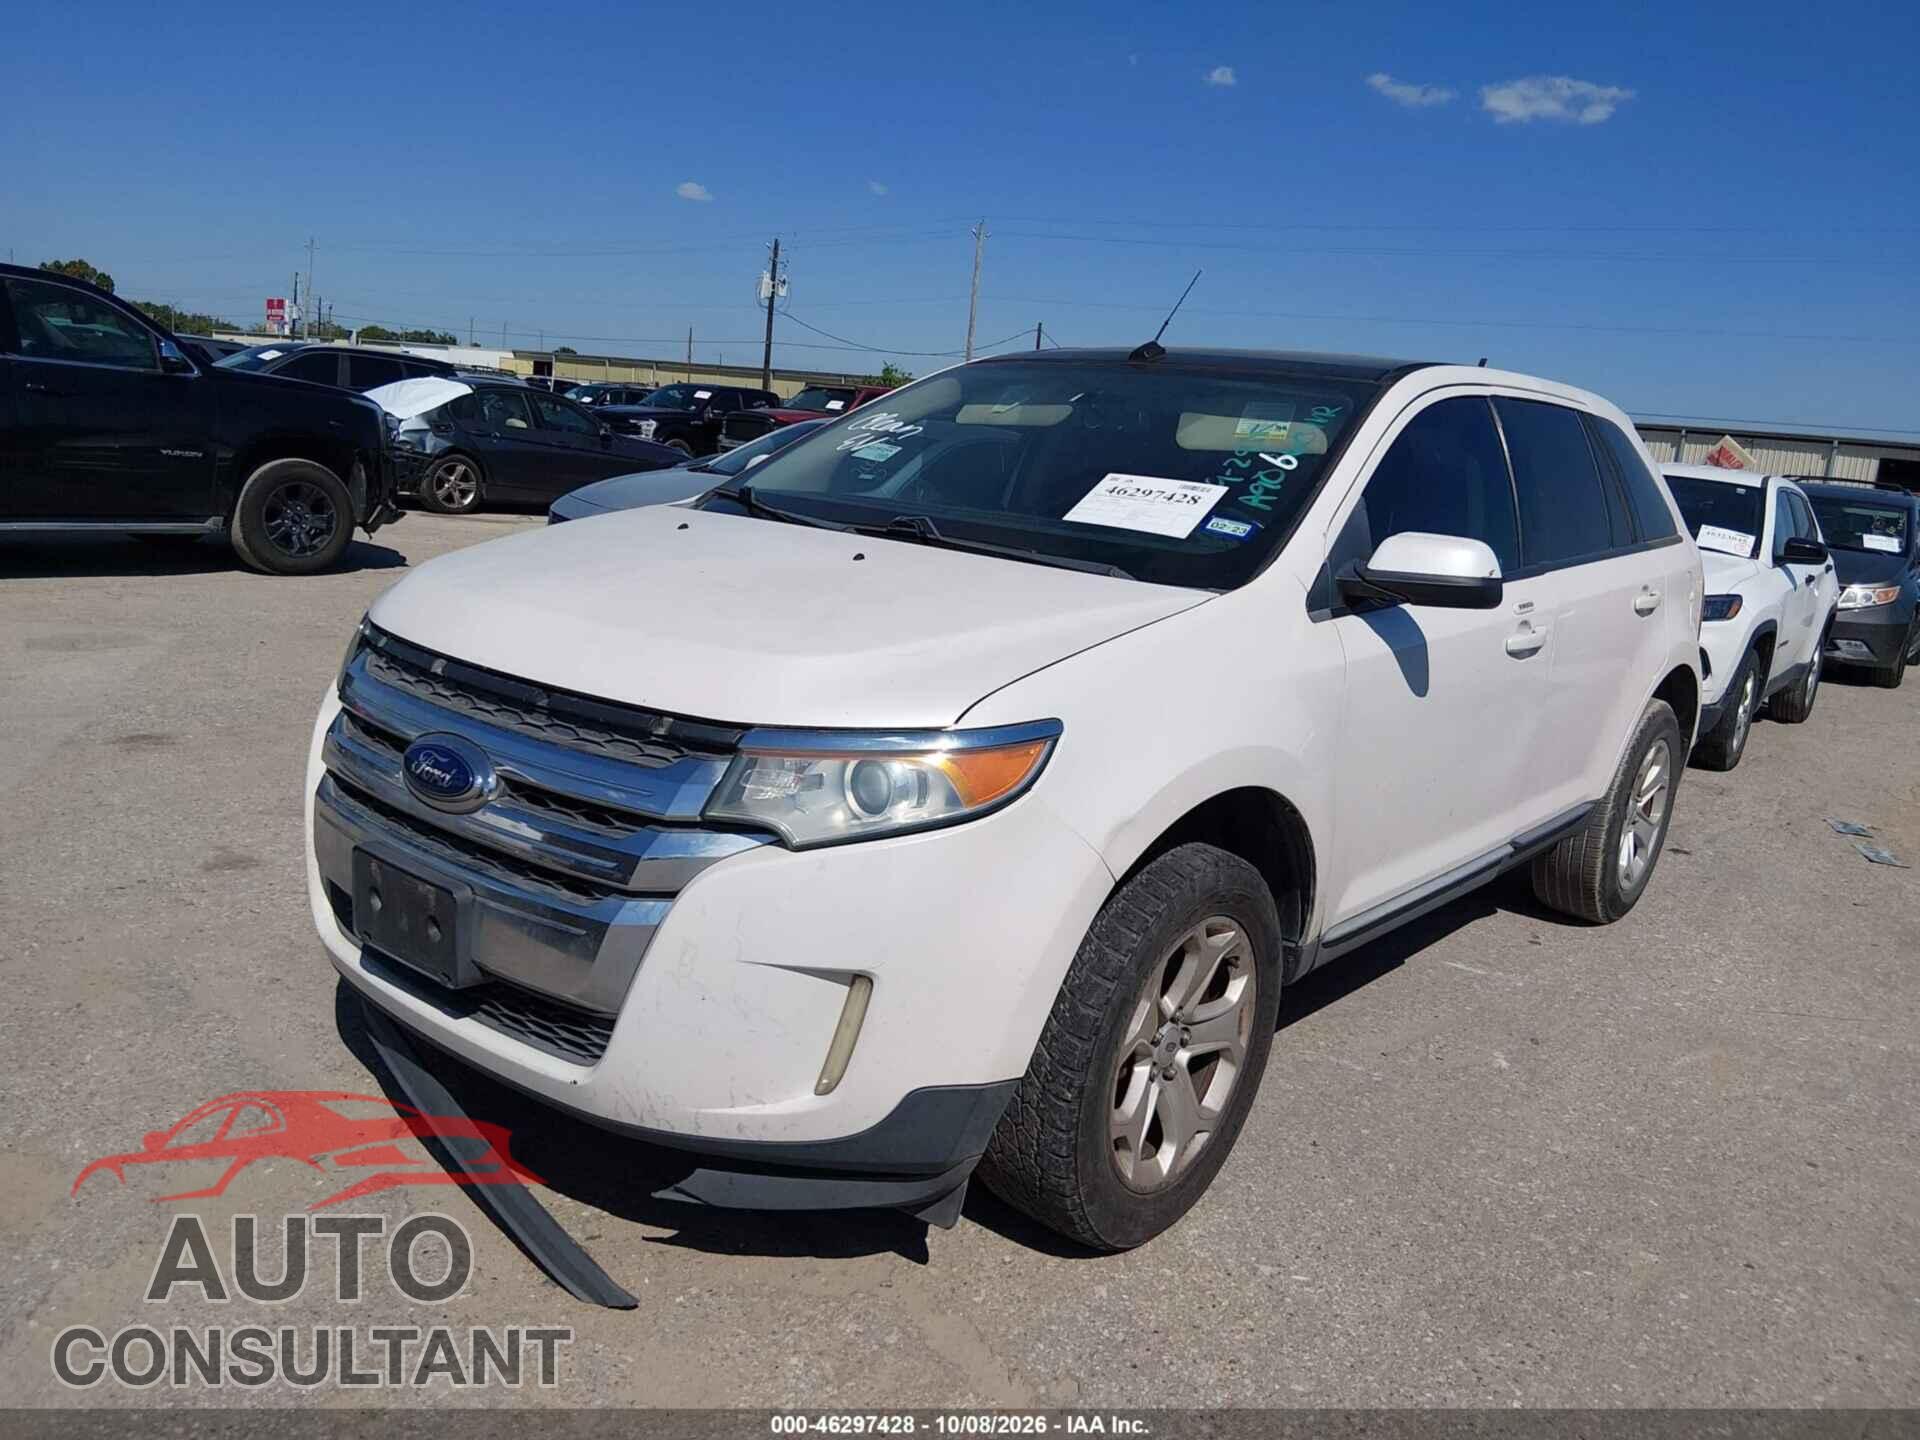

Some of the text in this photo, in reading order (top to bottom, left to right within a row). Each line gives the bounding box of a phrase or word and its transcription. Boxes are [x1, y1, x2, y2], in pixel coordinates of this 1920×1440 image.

[160, 449, 204, 457] YUKON
[1105, 485, 1202, 506] 46297428
[411, 750, 458, 788] Ford
